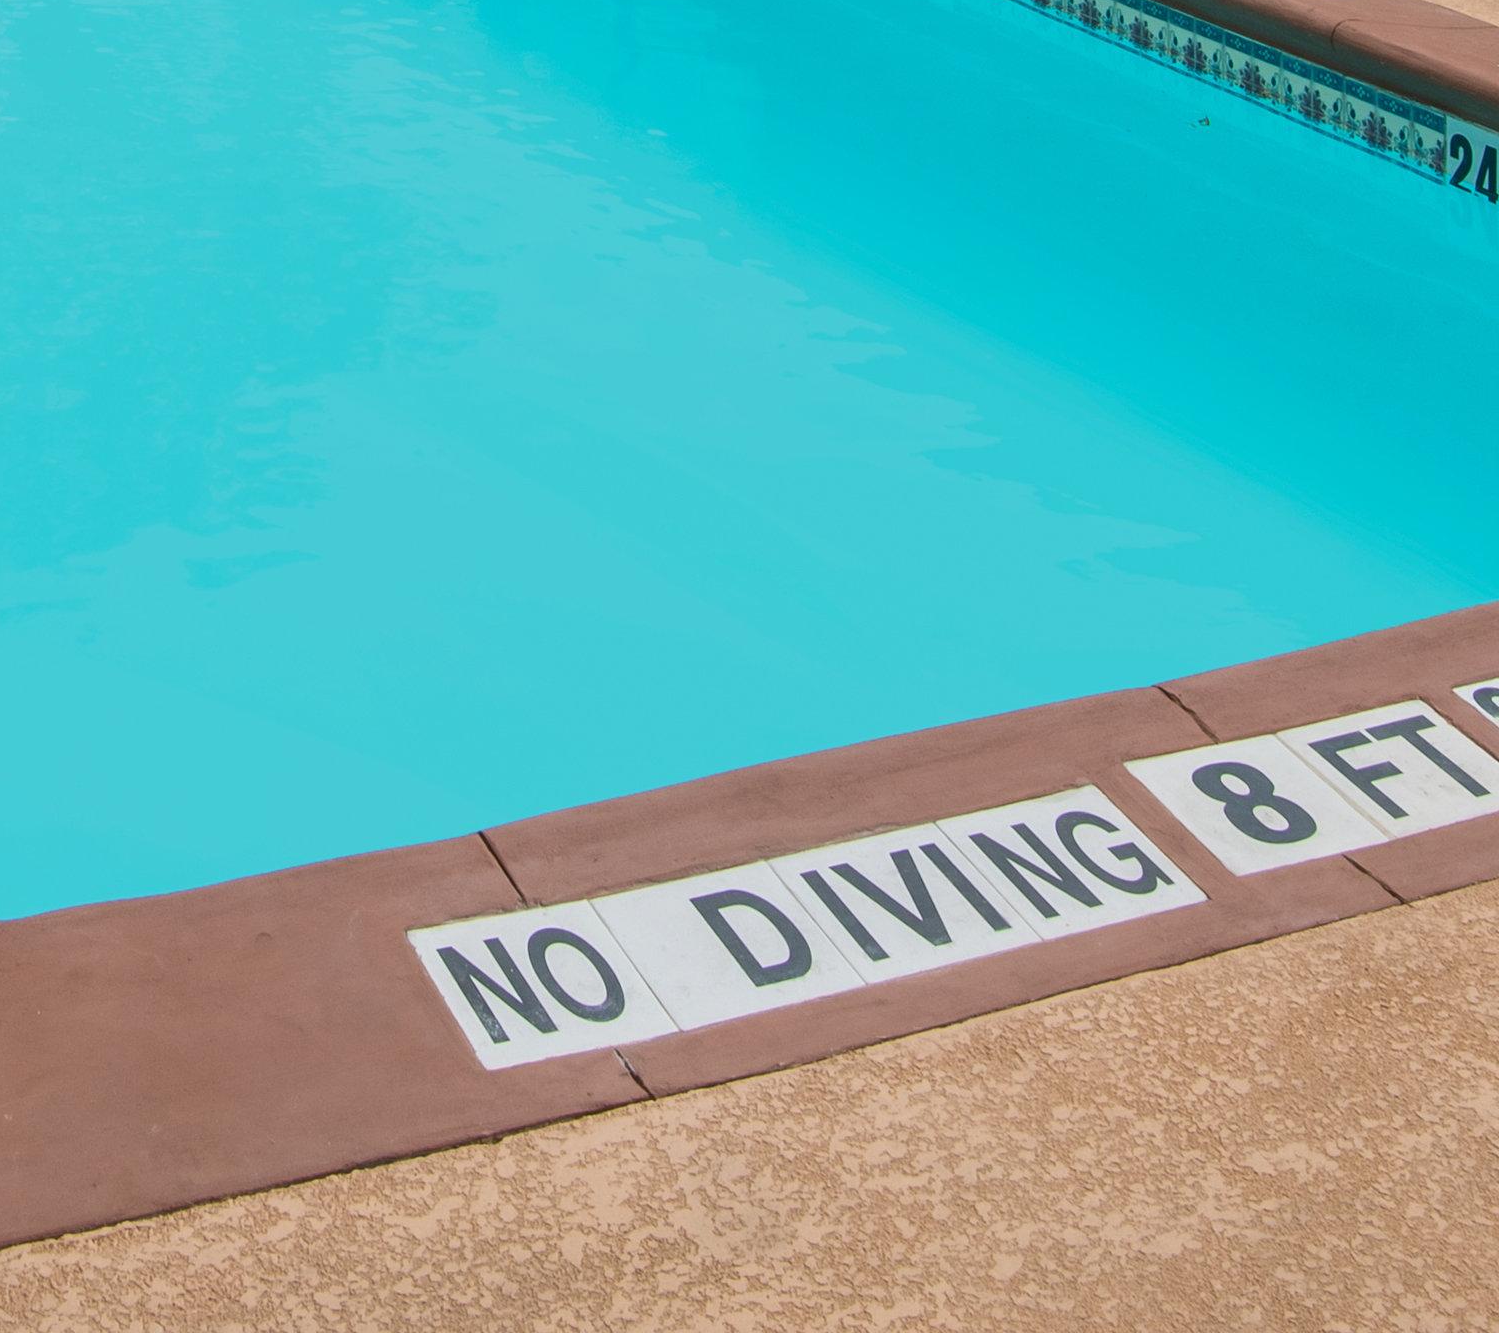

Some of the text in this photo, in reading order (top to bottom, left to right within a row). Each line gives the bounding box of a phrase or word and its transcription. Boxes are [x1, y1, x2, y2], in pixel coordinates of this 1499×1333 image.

[1191, 714, 1492, 845] 8 FT
[437, 810, 1175, 1044] NO DIVING
